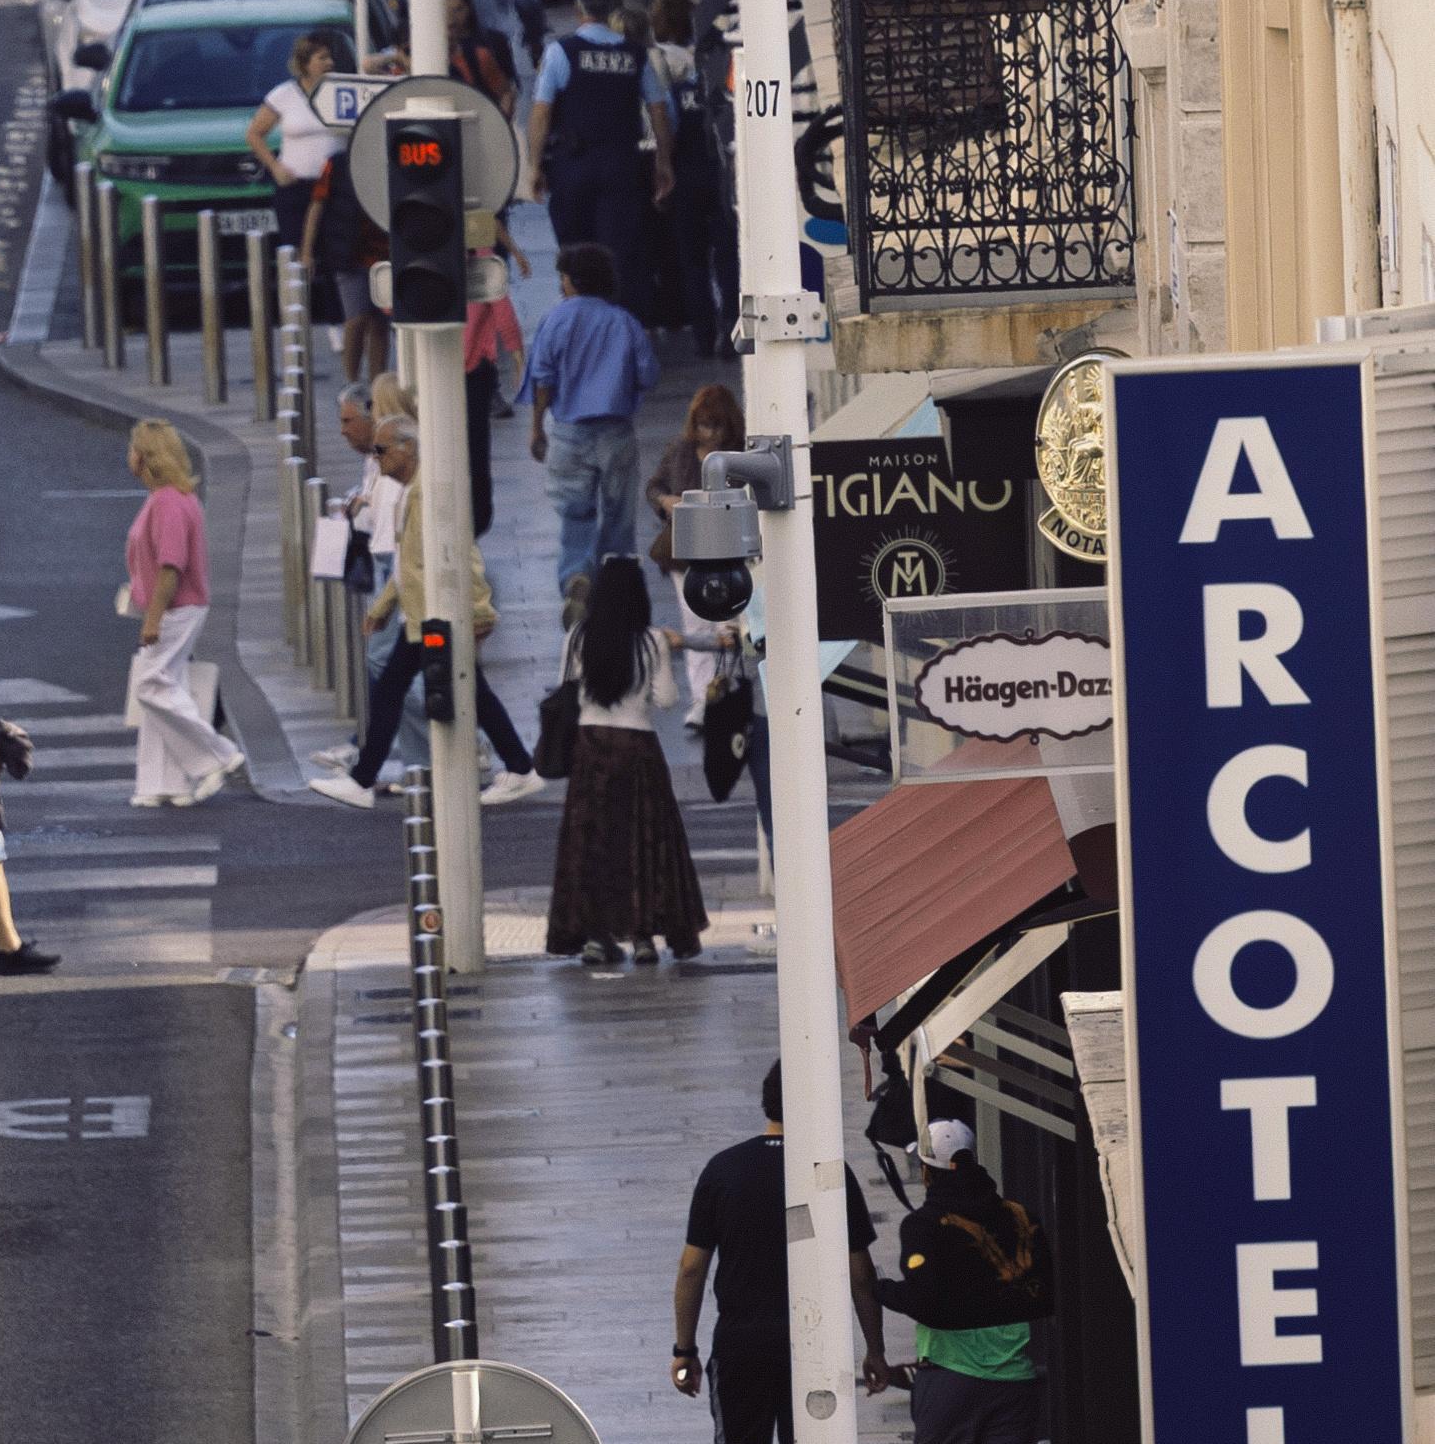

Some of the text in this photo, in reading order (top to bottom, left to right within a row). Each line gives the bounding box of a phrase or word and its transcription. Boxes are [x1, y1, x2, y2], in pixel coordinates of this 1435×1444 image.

[746, 79, 780, 117] 207
[398, 143, 442, 167] BUS
[868, 454, 938, 467] MAISON
